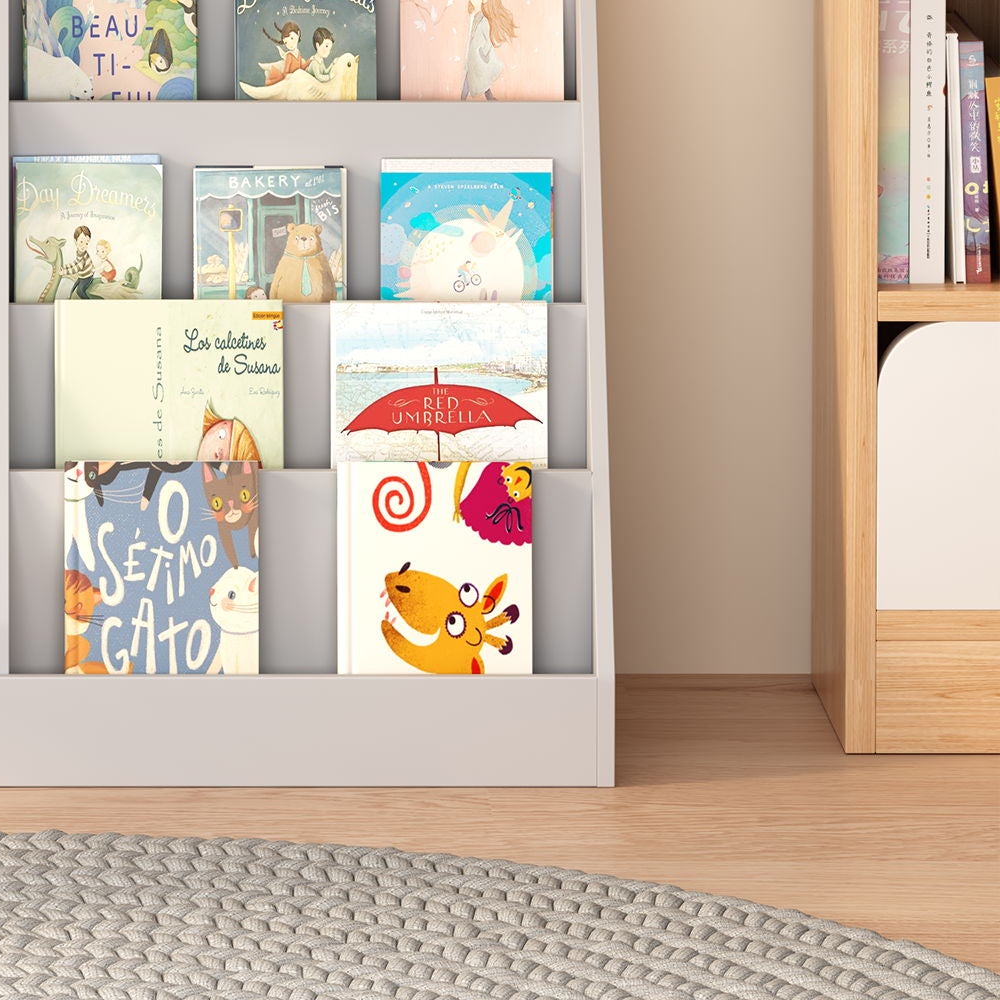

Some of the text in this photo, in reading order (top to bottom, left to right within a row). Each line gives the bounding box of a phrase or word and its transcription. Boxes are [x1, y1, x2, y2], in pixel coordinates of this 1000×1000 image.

[71, 14, 154, 38] BEAU-
[92, 53, 131, 76] TI-
[17, 169, 156, 218] Day Dreamers
[228, 175, 301, 188] BAKERY
[183, 328, 267, 353] Los calcetines
[152, 326, 165, 403] Susana
[217, 353, 281, 375] de Susana
[423, 396, 459, 410] RED
[432, 387, 449, 395] THE
[152, 408, 163, 432] de
[391, 410, 492, 427] UMBRELLA
[158, 480, 190, 544] O
[101, 597, 212, 674] GATO
